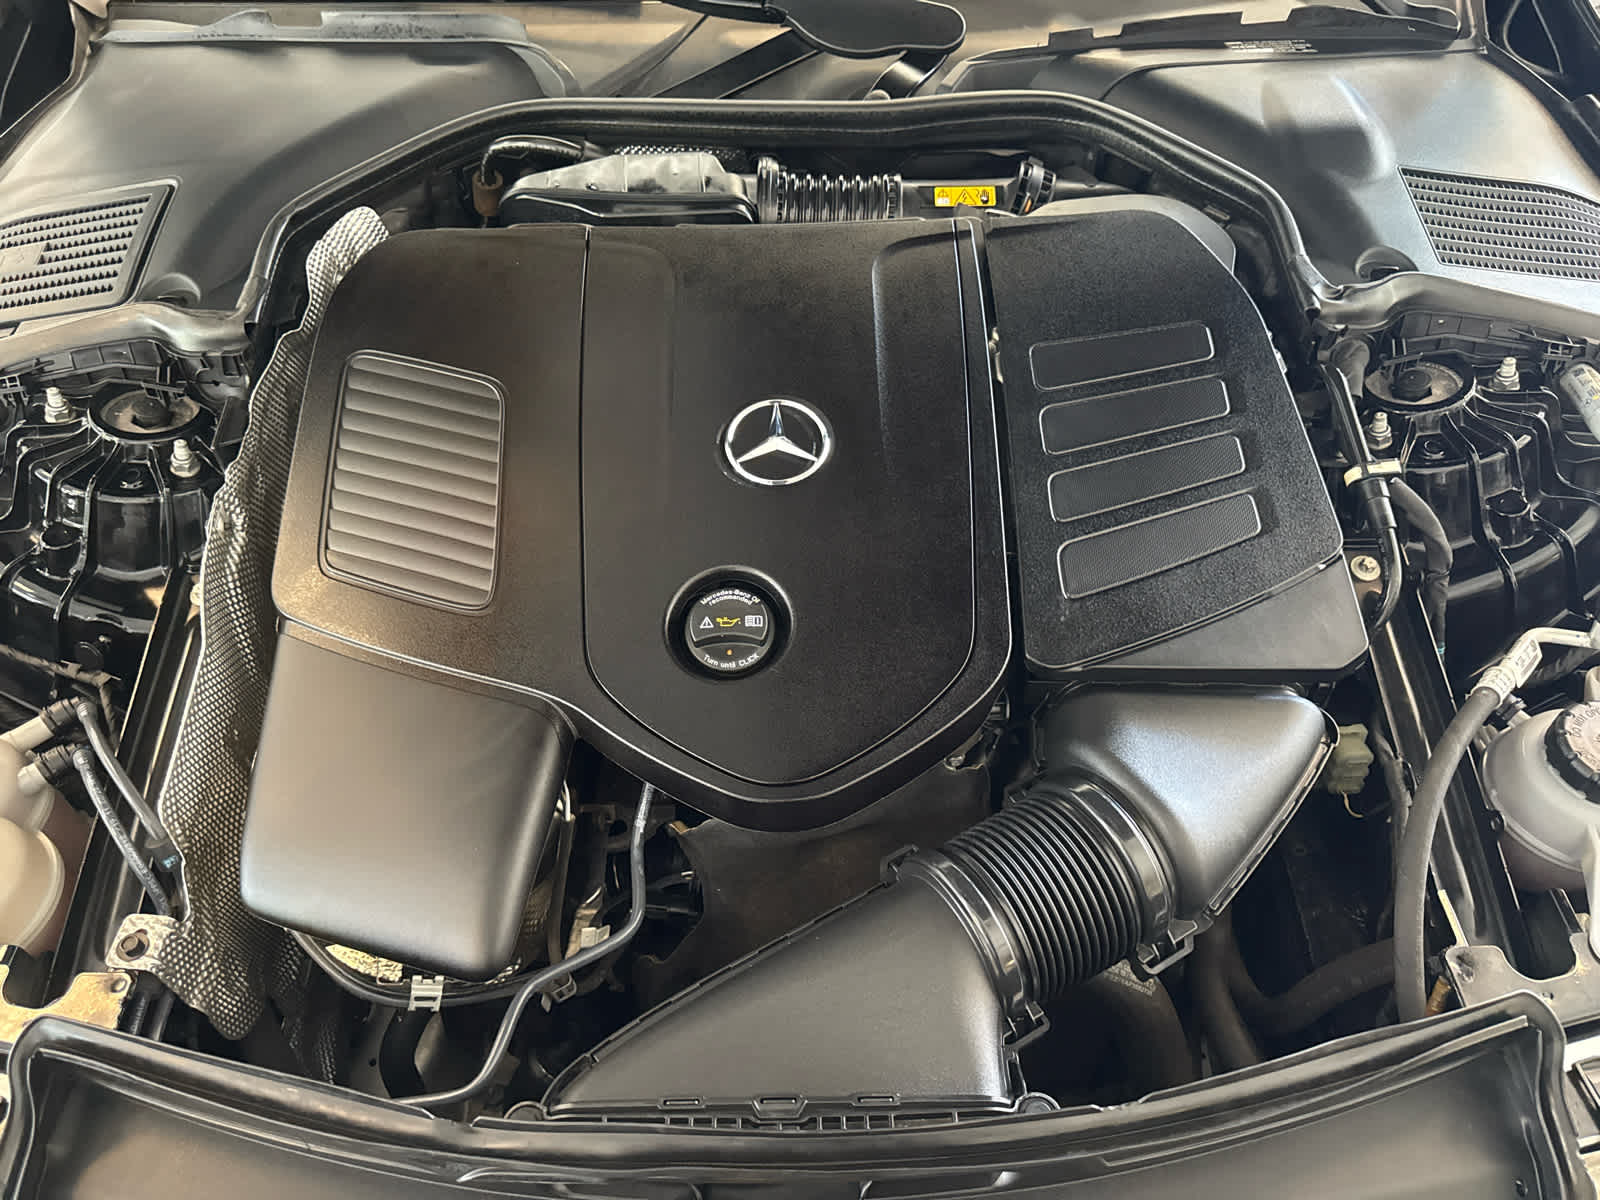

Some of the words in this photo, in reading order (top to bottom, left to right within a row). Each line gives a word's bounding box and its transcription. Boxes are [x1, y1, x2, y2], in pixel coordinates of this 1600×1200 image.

[700, 589, 752, 605] Mercedes-Benz
[709, 595, 753, 606] recommended
[703, 654, 718, 666] Turn
[720, 661, 736, 669] until
[738, 653, 760, 667] CLICK
